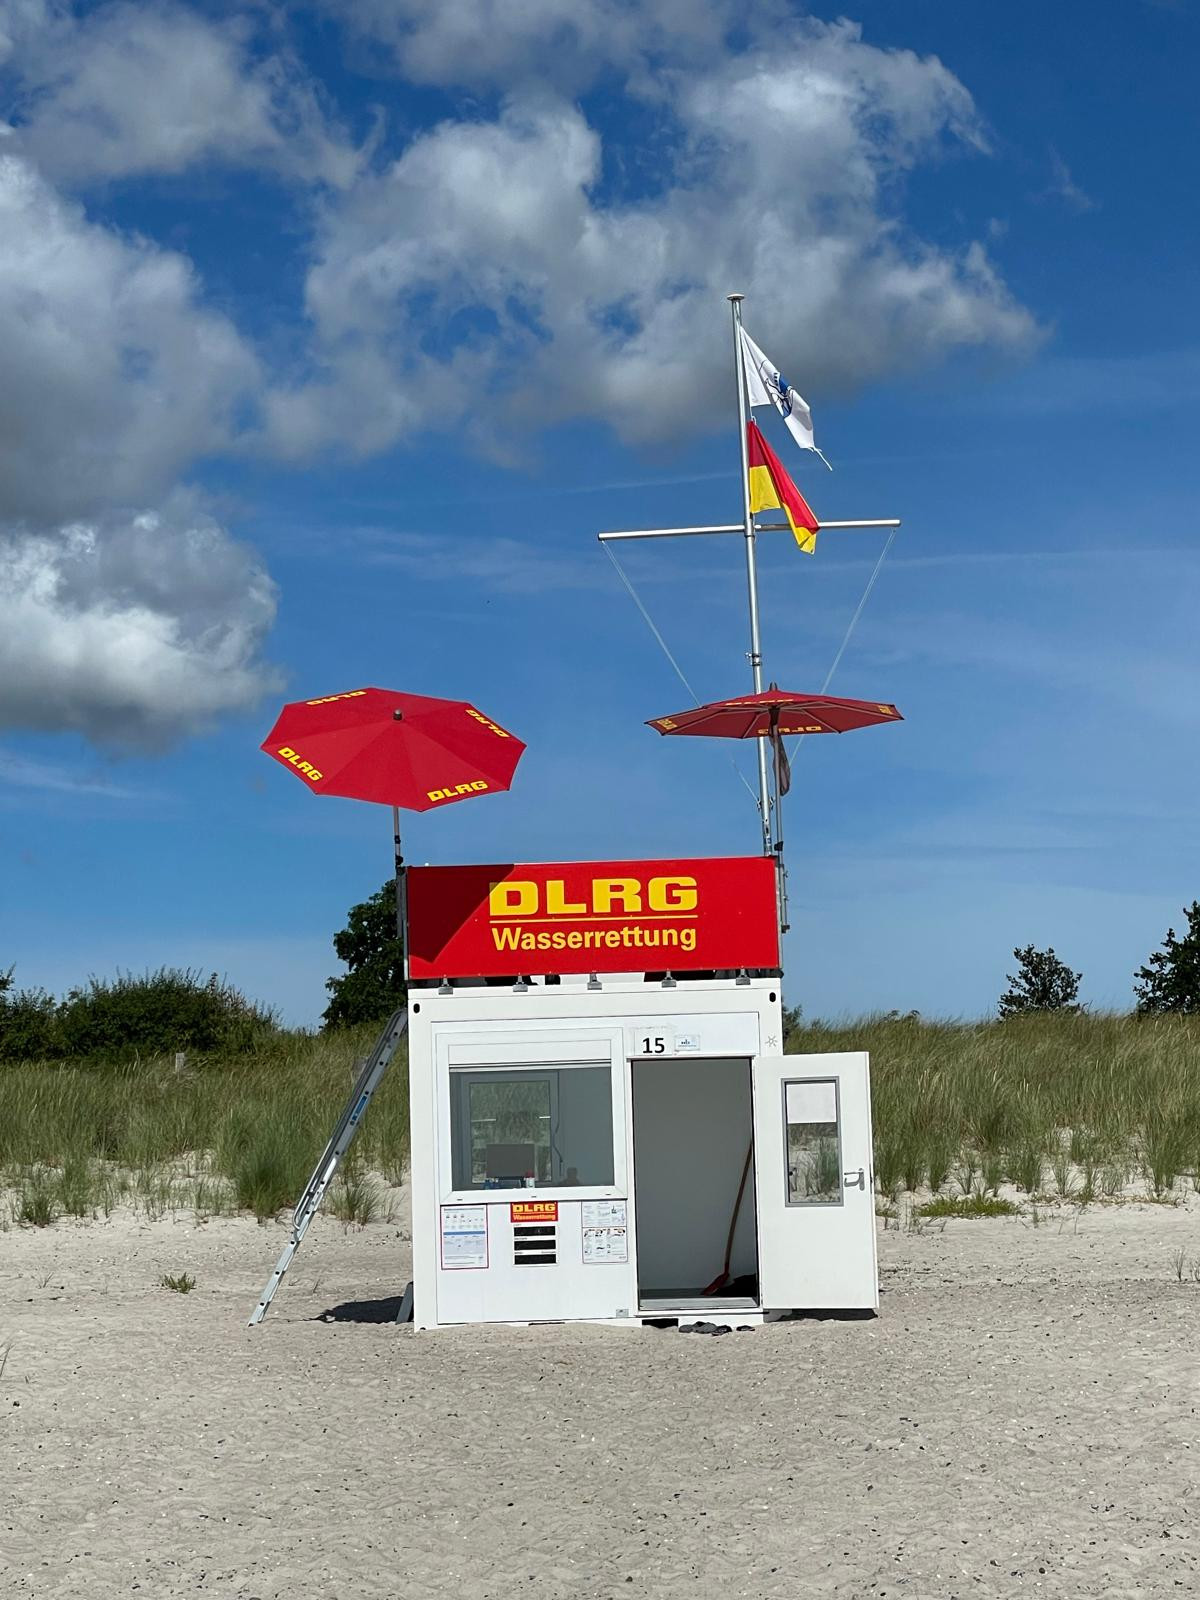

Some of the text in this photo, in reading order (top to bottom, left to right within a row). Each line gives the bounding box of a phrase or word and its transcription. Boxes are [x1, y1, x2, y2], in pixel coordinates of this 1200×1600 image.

[277, 747, 323, 781] DLRG
[427, 781, 488, 802] DLRG
[489, 876, 698, 917] DLRG
[491, 926, 697, 951] Wasserrettung
[642, 1037, 665, 1054] 15
[512, 1203, 556, 1213] DLRG
